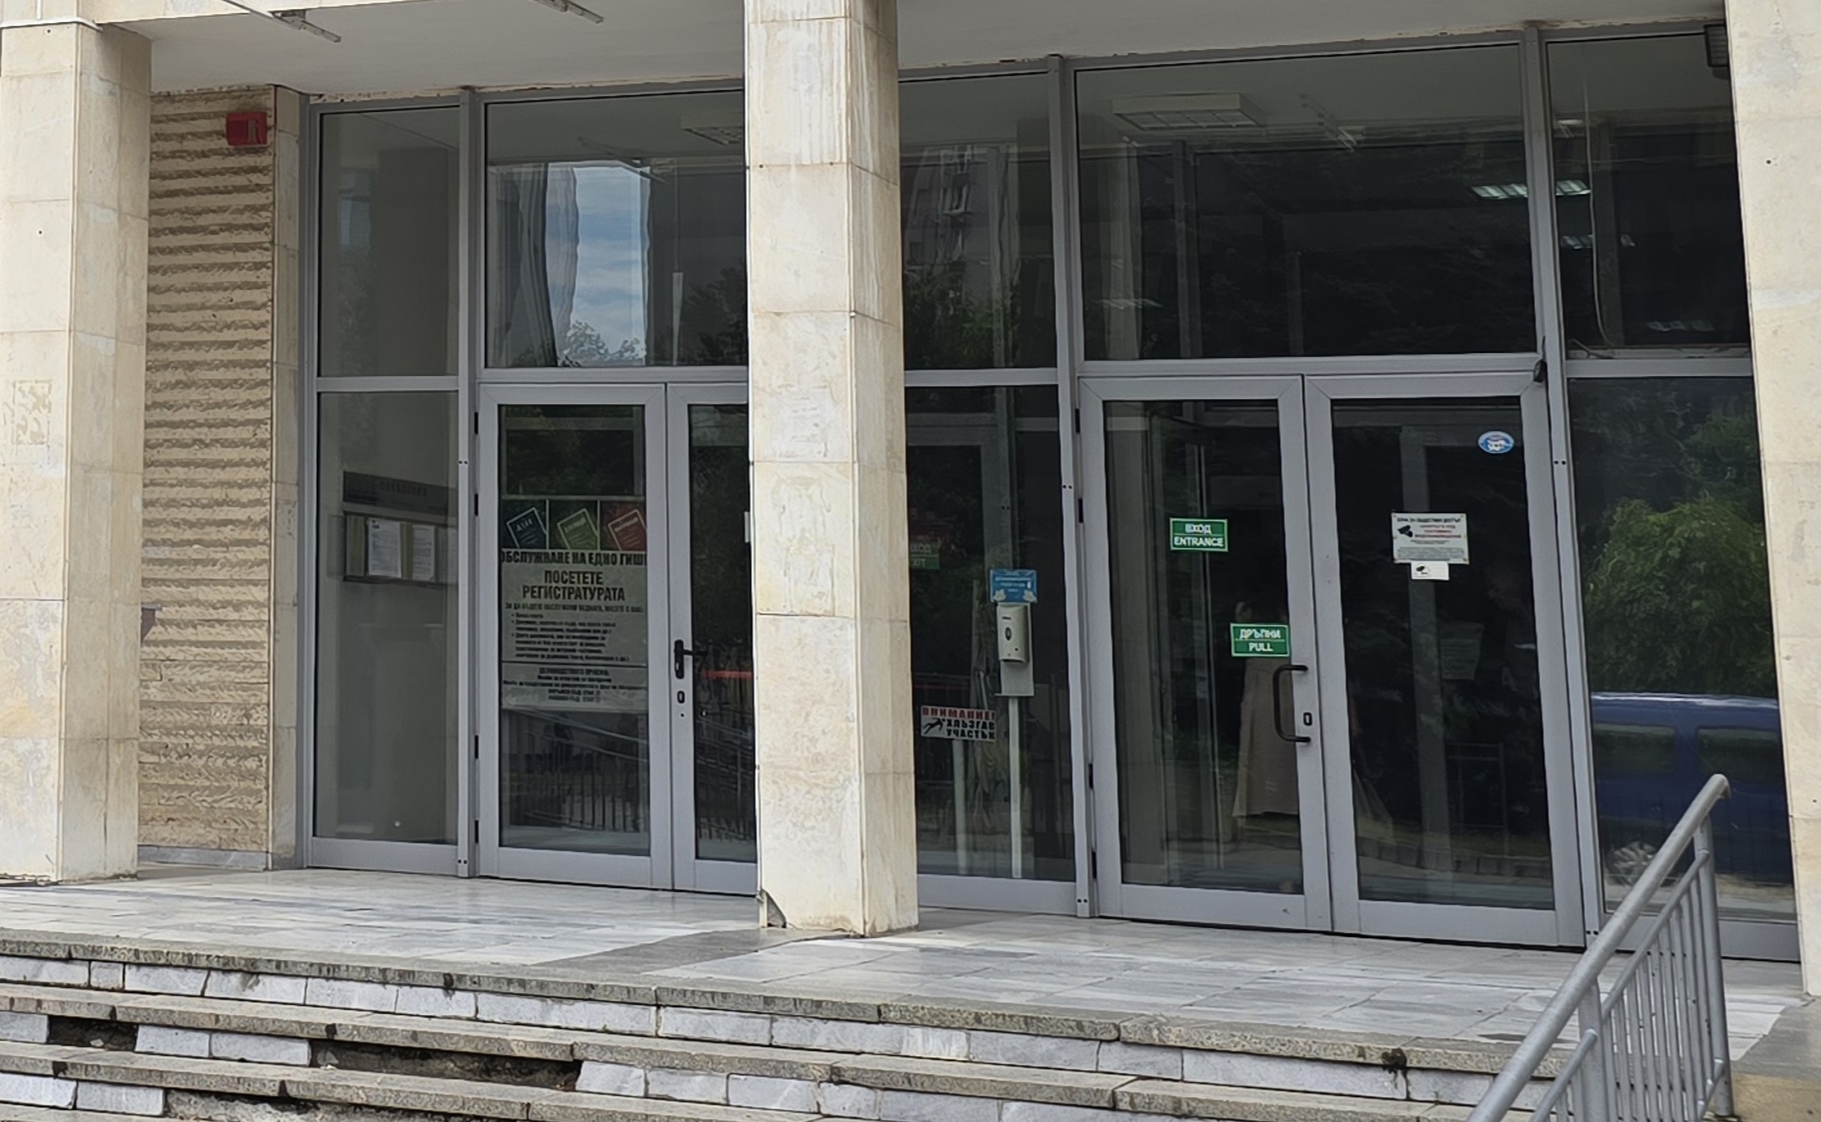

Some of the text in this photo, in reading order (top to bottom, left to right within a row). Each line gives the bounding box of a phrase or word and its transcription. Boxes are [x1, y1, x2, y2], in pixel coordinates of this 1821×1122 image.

[1185, 523, 1212, 534] ВХОД
[1174, 536, 1224, 547] ENTRANCE
[572, 552, 586, 565] НА
[589, 553, 617, 566] ЕДНО
[620, 553, 647, 566] ГИШ
[544, 570, 603, 585] ПОСЕТЕТЕ
[522, 585, 625, 601] РЕГИСТРАТУРАТА
[1239, 628, 1281, 640] ДРЪПНИ
[1248, 642, 1274, 652] PULL
[922, 707, 996, 720] ВНИМАНИЕ!
[946, 718, 995, 730] ХЛЪЗГАВ
[946, 728, 996, 740] УЧАСТЪК
